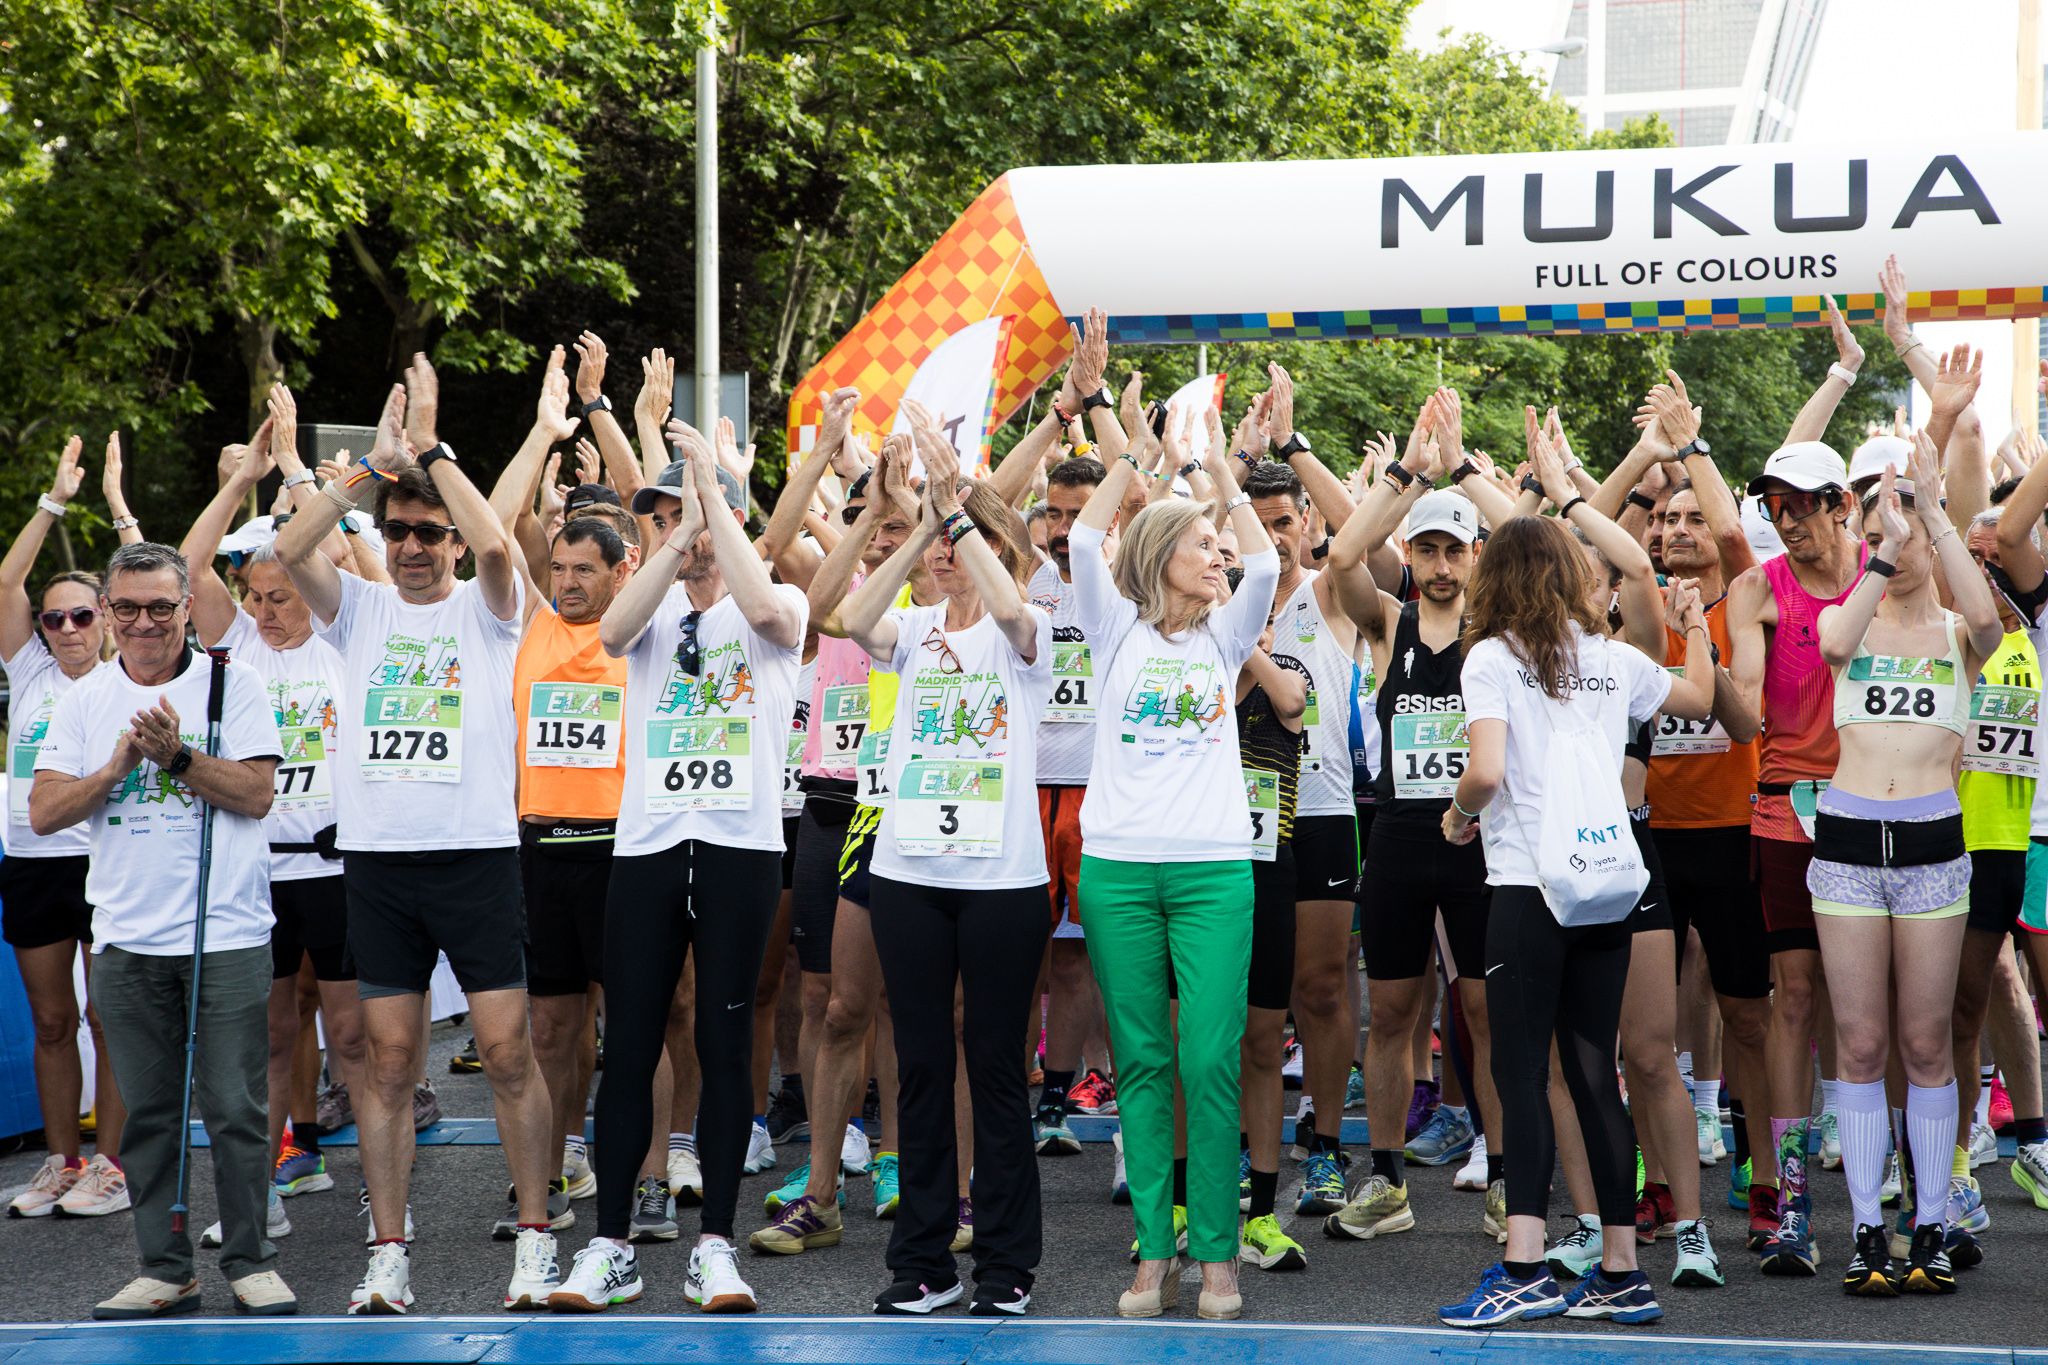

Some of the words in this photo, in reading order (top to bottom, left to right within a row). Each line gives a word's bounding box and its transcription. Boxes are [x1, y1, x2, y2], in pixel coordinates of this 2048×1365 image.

[1381, 154, 2002, 249] MUKUA
[1535, 264, 1608, 288] FULL
[1620, 261, 1663, 285] OF
[1676, 253, 1838, 283] COLOURS
[915, 676, 961, 685] MADRID
[986, 672, 999, 681] LA
[1049, 680, 1088, 705] 61
[1395, 693, 1463, 714] asisa
[1865, 686, 1936, 718] 828
[537, 722, 607, 750] 1154
[1655, 714, 1717, 736] 319
[369, 730, 449, 761] 1278
[1977, 725, 2034, 758] 571
[274, 766, 316, 795] 77
[664, 760, 733, 791] 698
[1405, 752, 1469, 780] 165
[939, 805, 959, 835] 3
